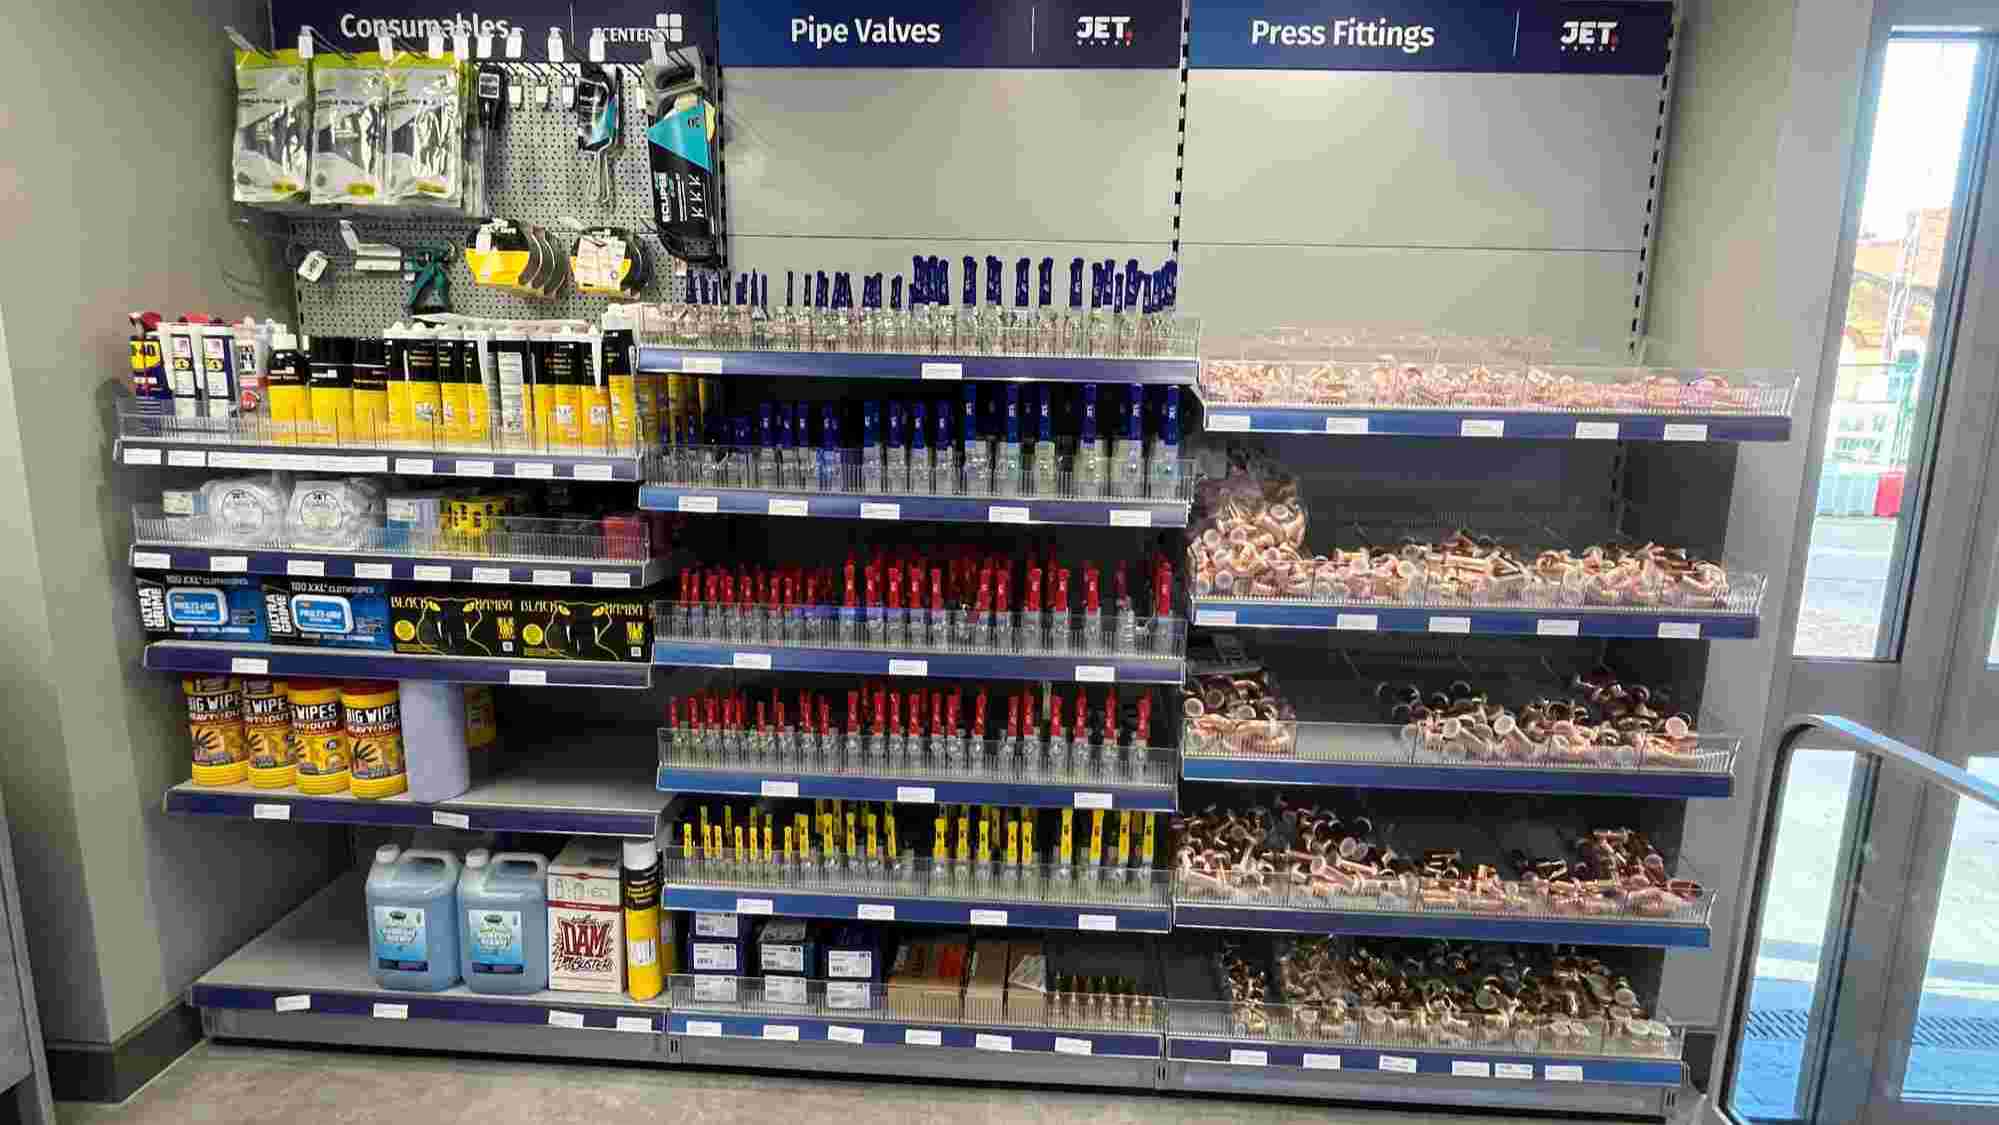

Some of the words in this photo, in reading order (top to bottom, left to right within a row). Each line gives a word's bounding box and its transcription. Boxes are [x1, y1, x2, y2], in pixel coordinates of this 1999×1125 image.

[340, 12, 509, 38] Consumables
[791, 15, 849, 49] Pipe
[854, 16, 941, 43] Valves
[1251, 20, 1326, 45] Press
[1333, 17, 1435, 54] Fittings
[138, 587, 153, 627] ULTRA
[266, 594, 282, 632] ULTRA
[560, 920, 609, 959] DAM
